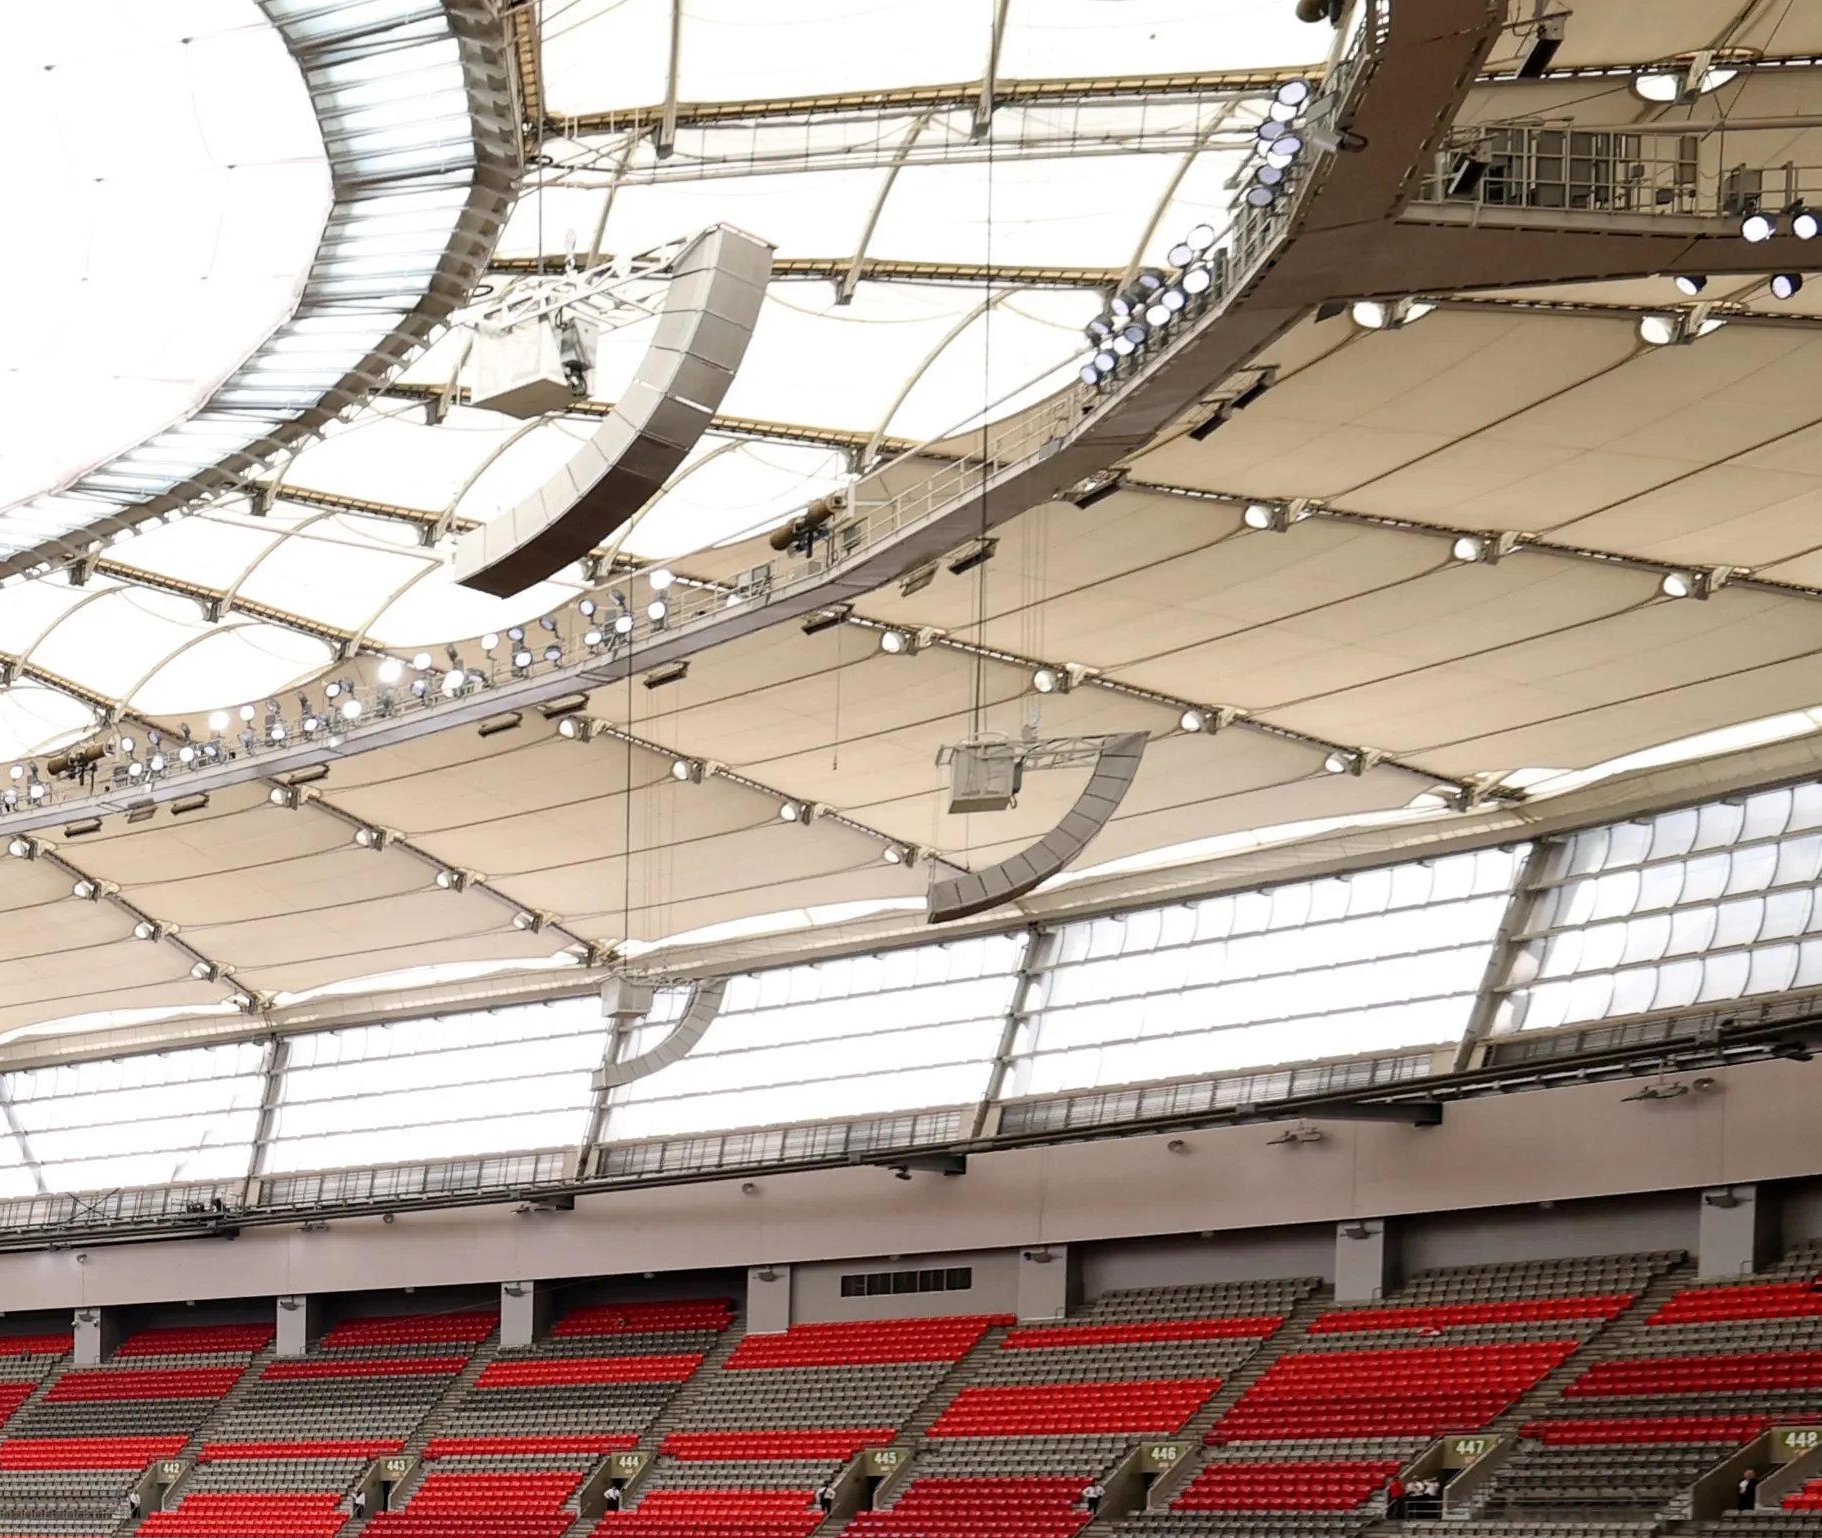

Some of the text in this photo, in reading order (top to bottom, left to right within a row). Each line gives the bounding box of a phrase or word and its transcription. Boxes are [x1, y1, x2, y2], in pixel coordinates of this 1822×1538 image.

[1151, 1446, 1177, 1460] 446
[1456, 1440, 1485, 1454] 447
[619, 1456, 640, 1468] 444
[874, 1451, 897, 1464] 445
[163, 1463, 180, 1474] 442
[386, 1459, 405, 1471] 443
